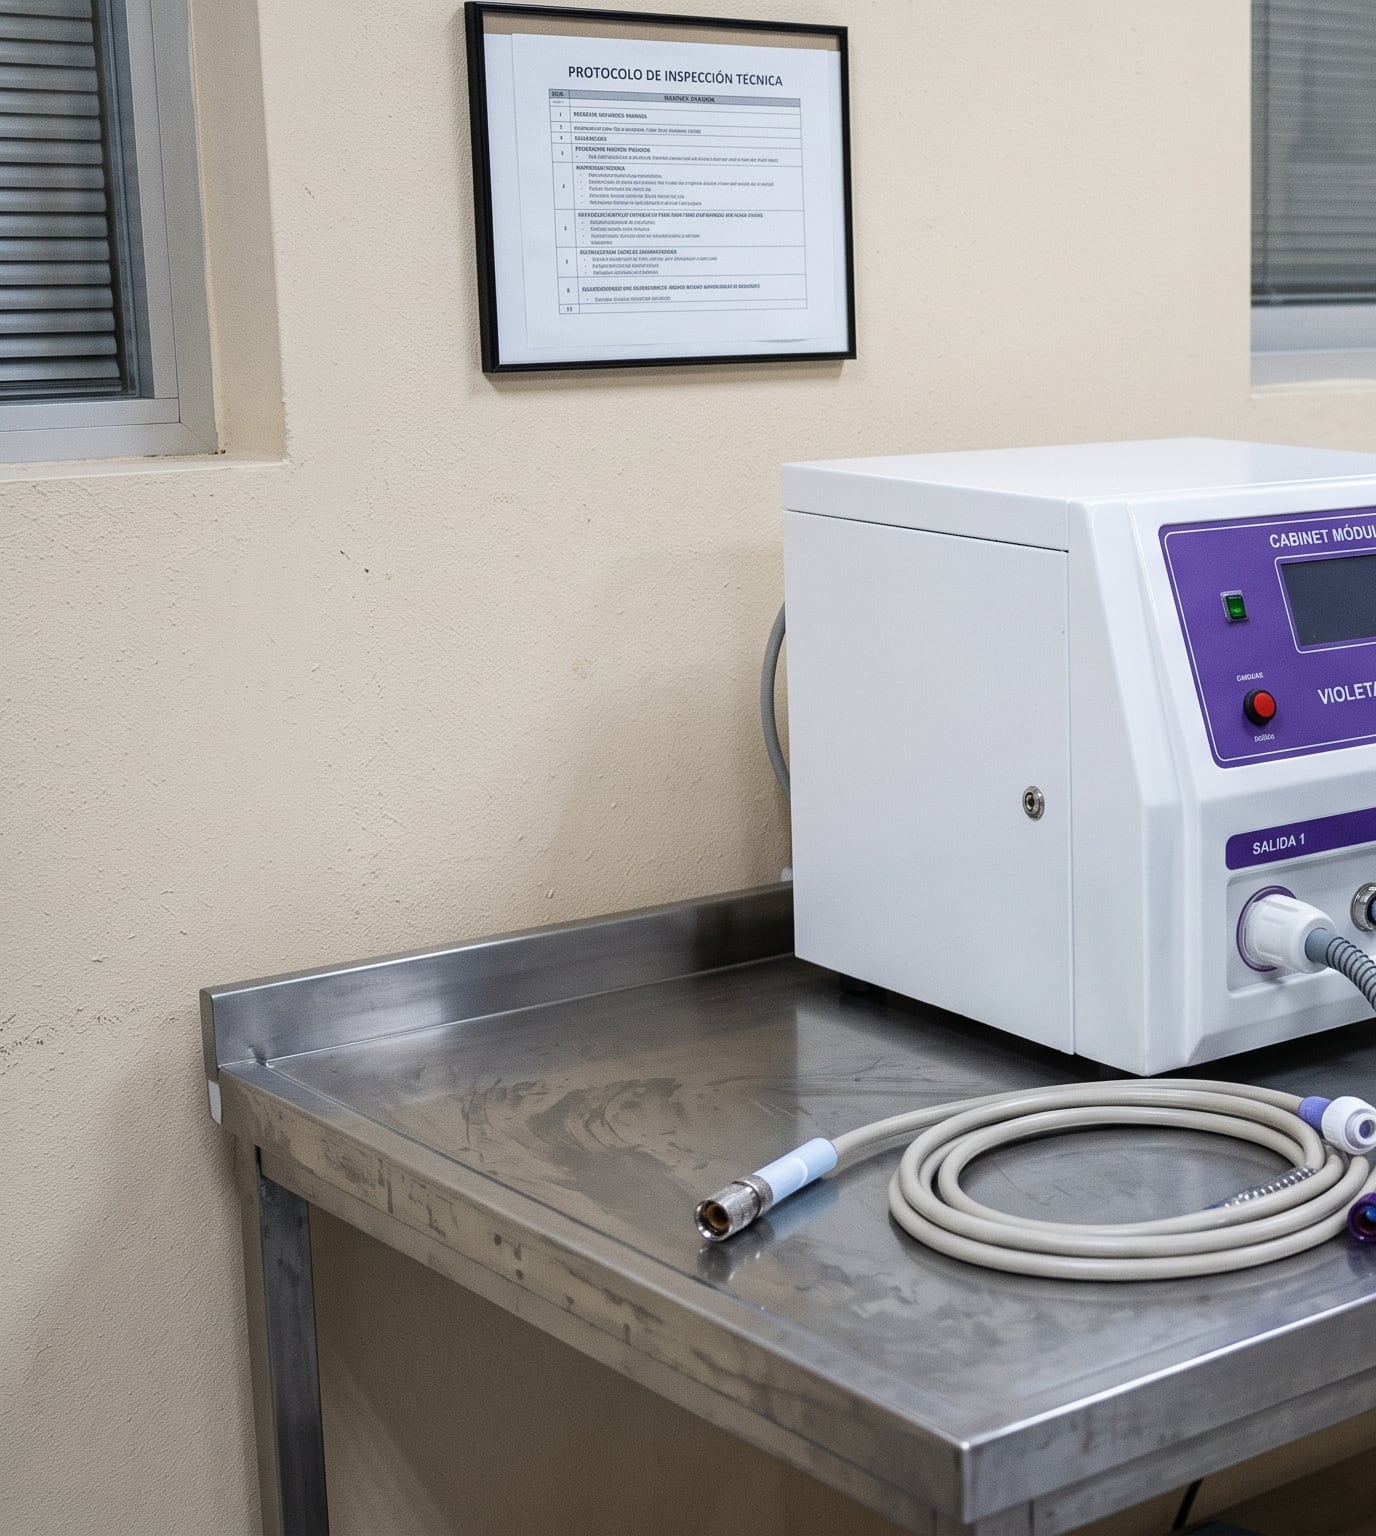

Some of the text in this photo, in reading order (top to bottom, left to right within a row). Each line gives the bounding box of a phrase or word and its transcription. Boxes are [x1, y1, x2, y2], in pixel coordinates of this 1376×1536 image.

[568, 66, 643, 81] PROTOCOLO
[646, 69, 662, 81] DE
[664, 70, 733, 84] INSPECCIÓN
[1269, 529, 1329, 548] CABINET
[1252, 833, 1305, 855] SALIDA 1
